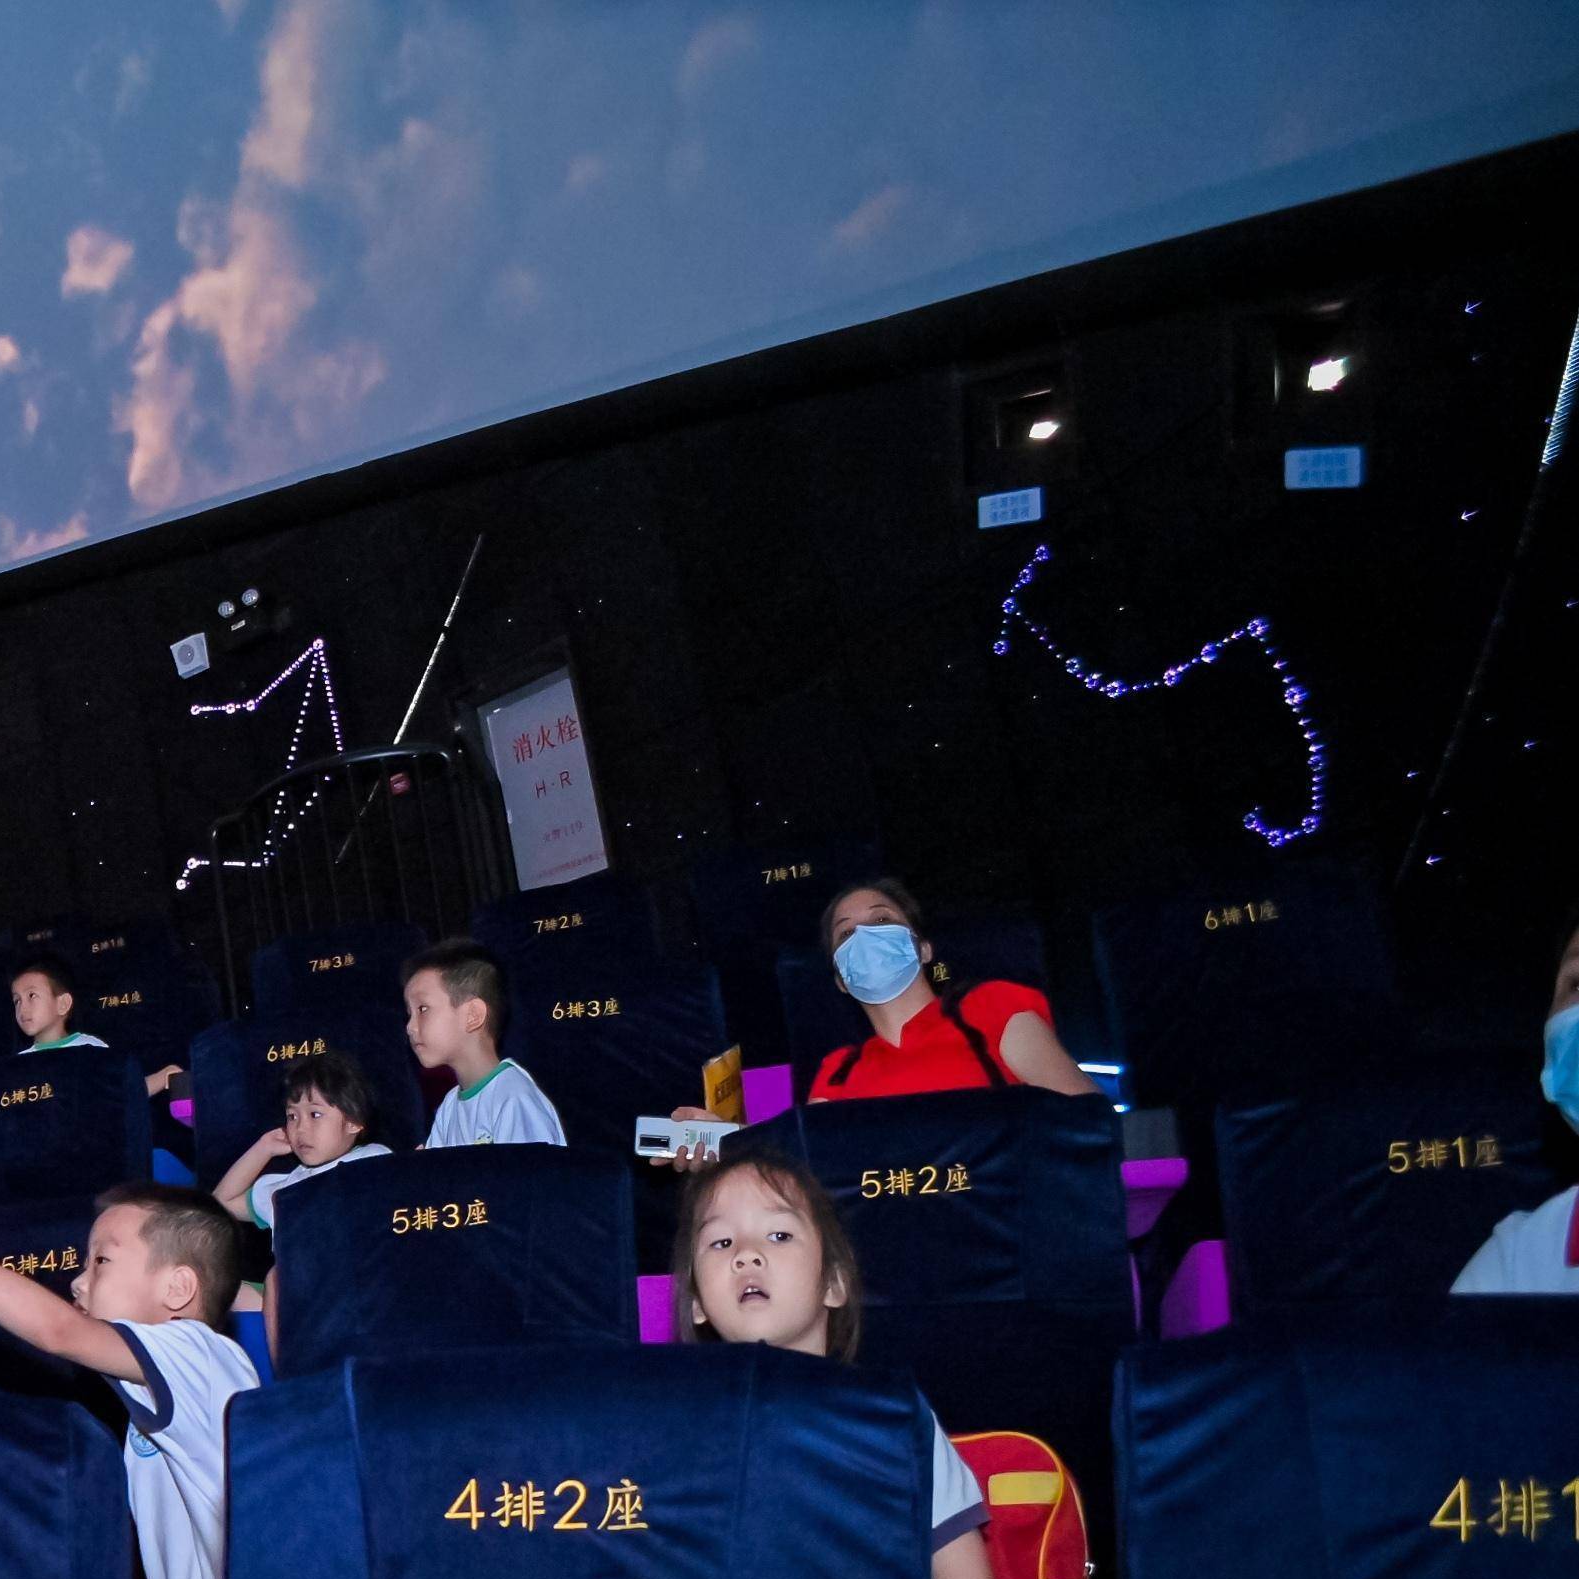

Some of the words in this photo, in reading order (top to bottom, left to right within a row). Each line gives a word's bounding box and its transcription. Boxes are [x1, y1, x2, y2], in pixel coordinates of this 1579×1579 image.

[512, 714, 579, 764] 消火栓
[761, 861, 812, 884] 7排1座
[532, 912, 584, 933] 7排2座
[1204, 900, 1279, 930] 6排1座
[308, 952, 355, 973] 7排3座
[552, 996, 621, 1020] 6排3座
[266, 1036, 327, 1063] 6排4座
[0, 1082, 54, 1107] 6排5座
[1387, 1135, 1504, 1174] 5排1座
[860, 1162, 972, 1199] 5排2座
[391, 1198, 490, 1235] 5排3座
[2, 1246, 80, 1276] 5排4座
[443, 1478, 649, 1532] 4排2座
